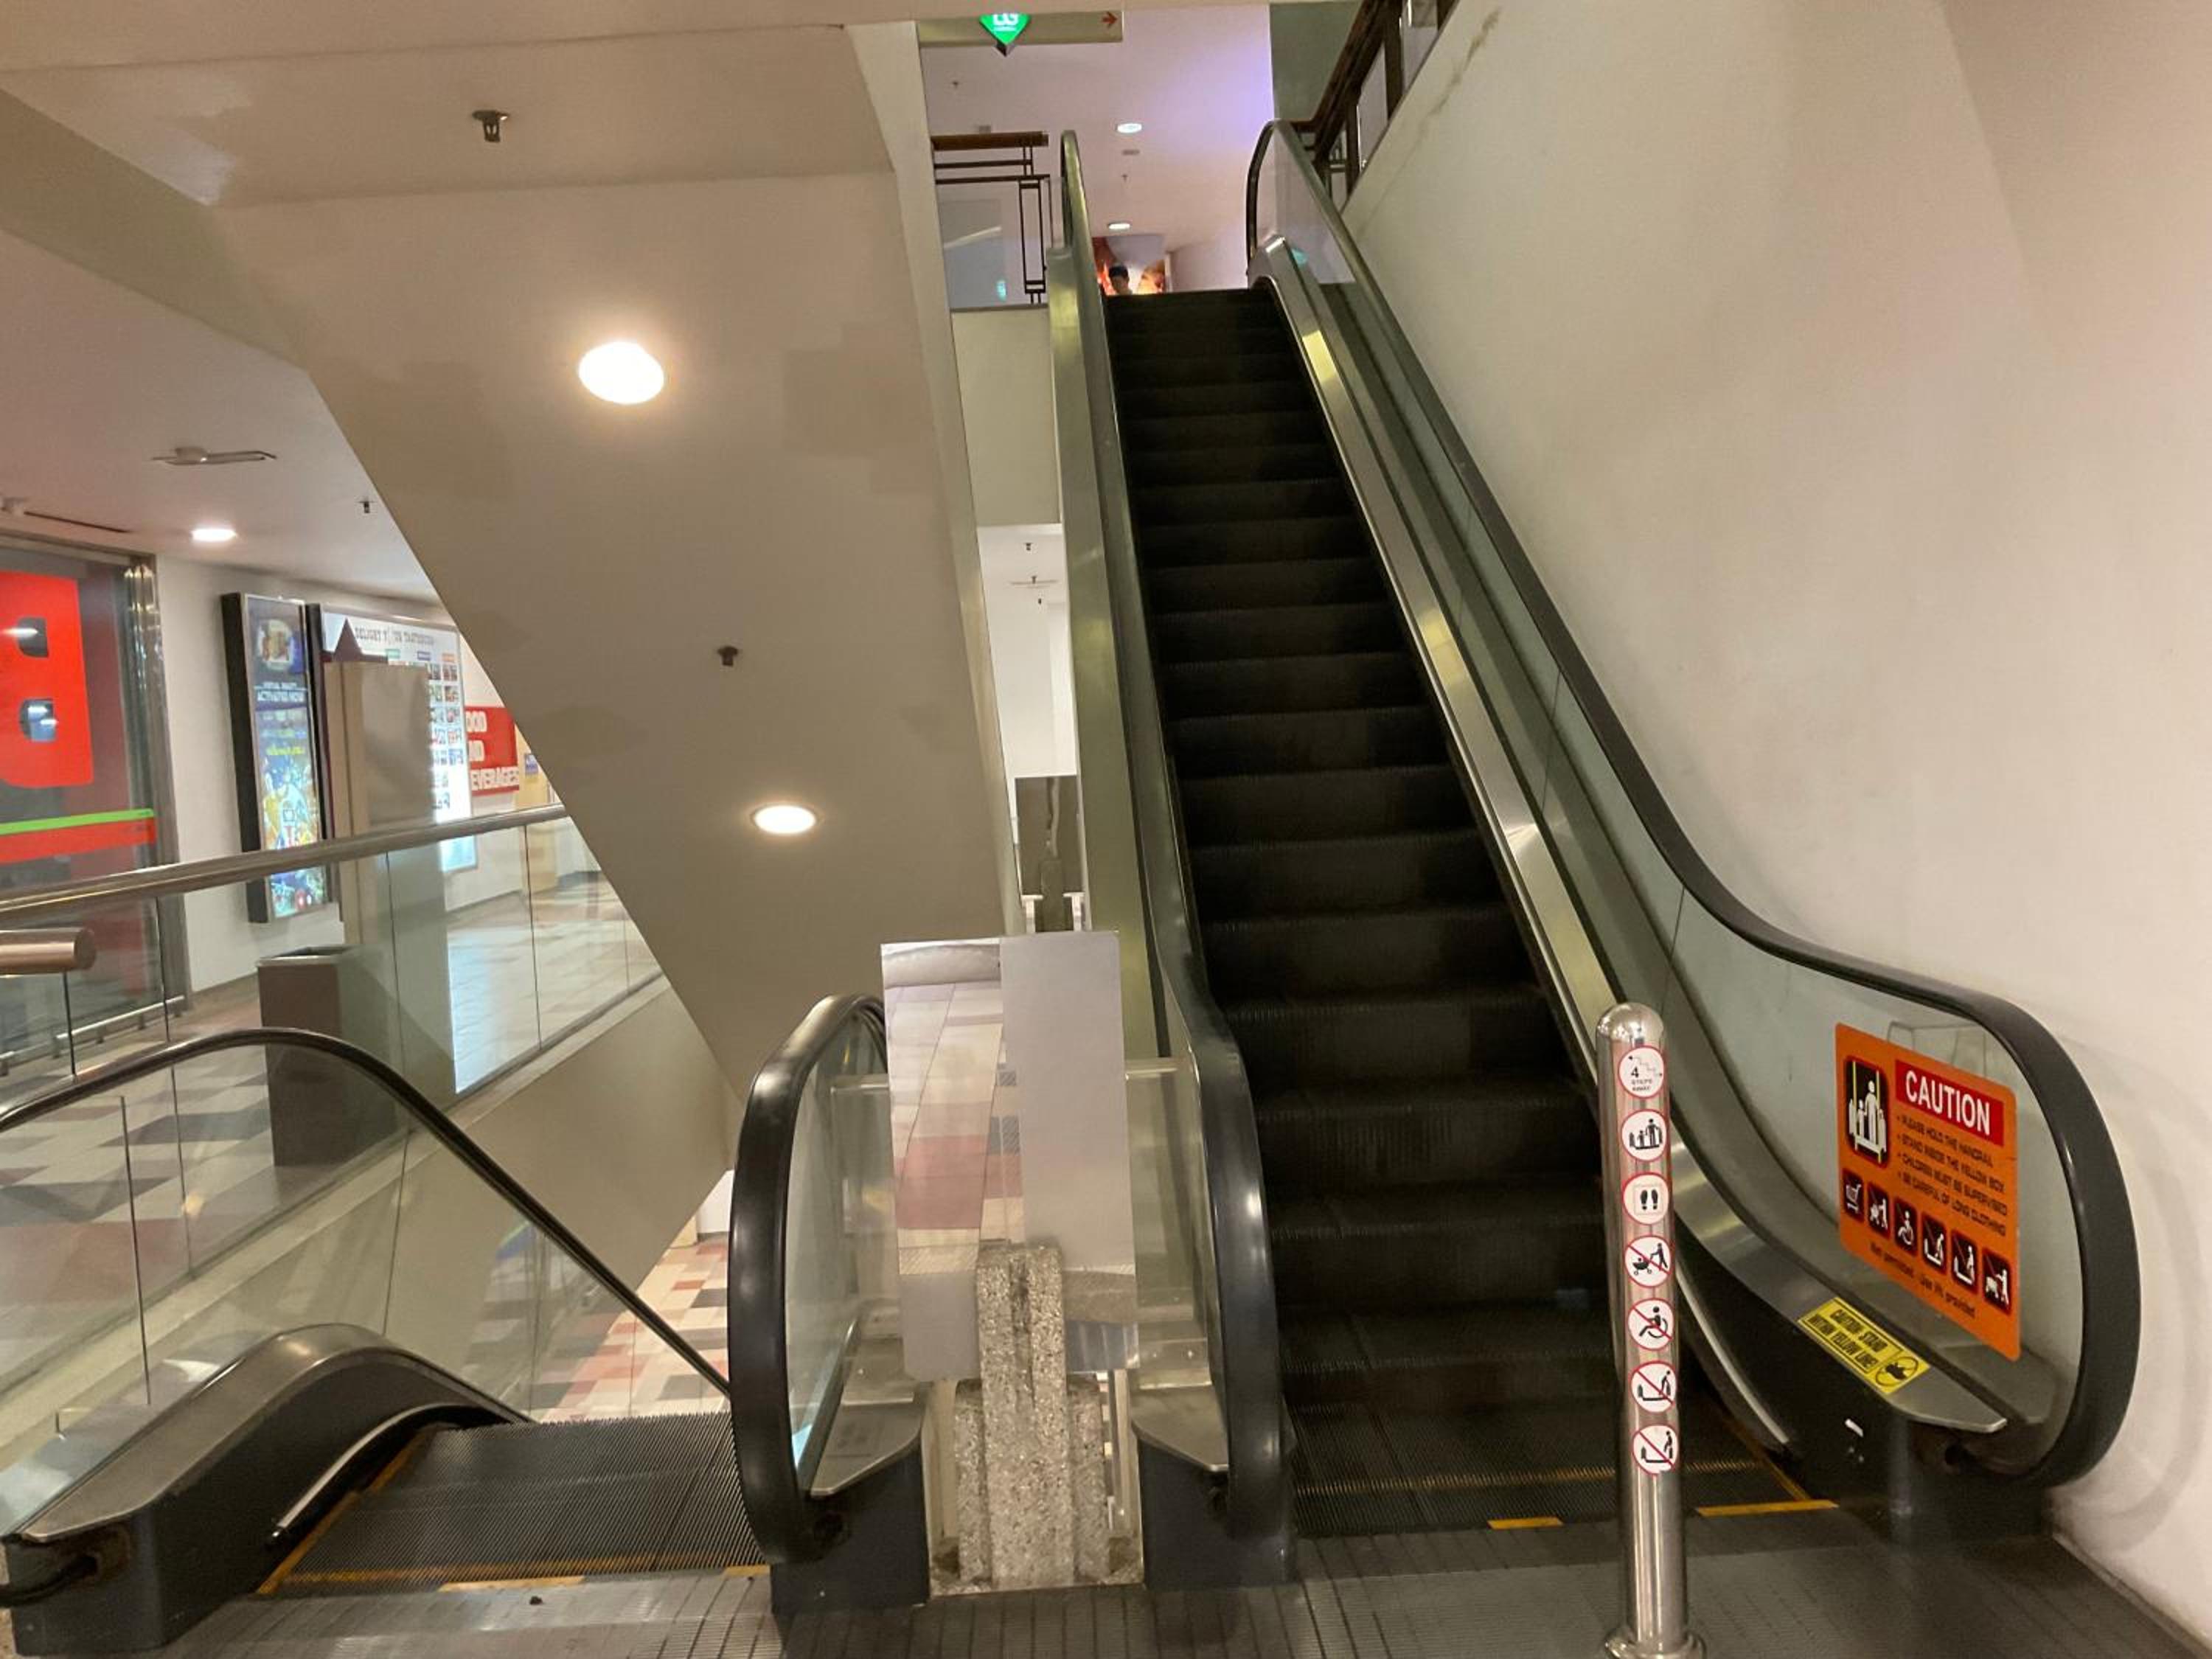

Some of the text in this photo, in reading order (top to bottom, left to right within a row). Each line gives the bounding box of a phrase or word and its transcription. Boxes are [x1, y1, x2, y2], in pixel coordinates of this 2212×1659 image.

[466, 710, 487, 732] OOD
[470, 765, 520, 791] EVERAGES
[1631, 1066, 1639, 1078] 4
[1905, 1070, 1990, 1135] CAUTION
